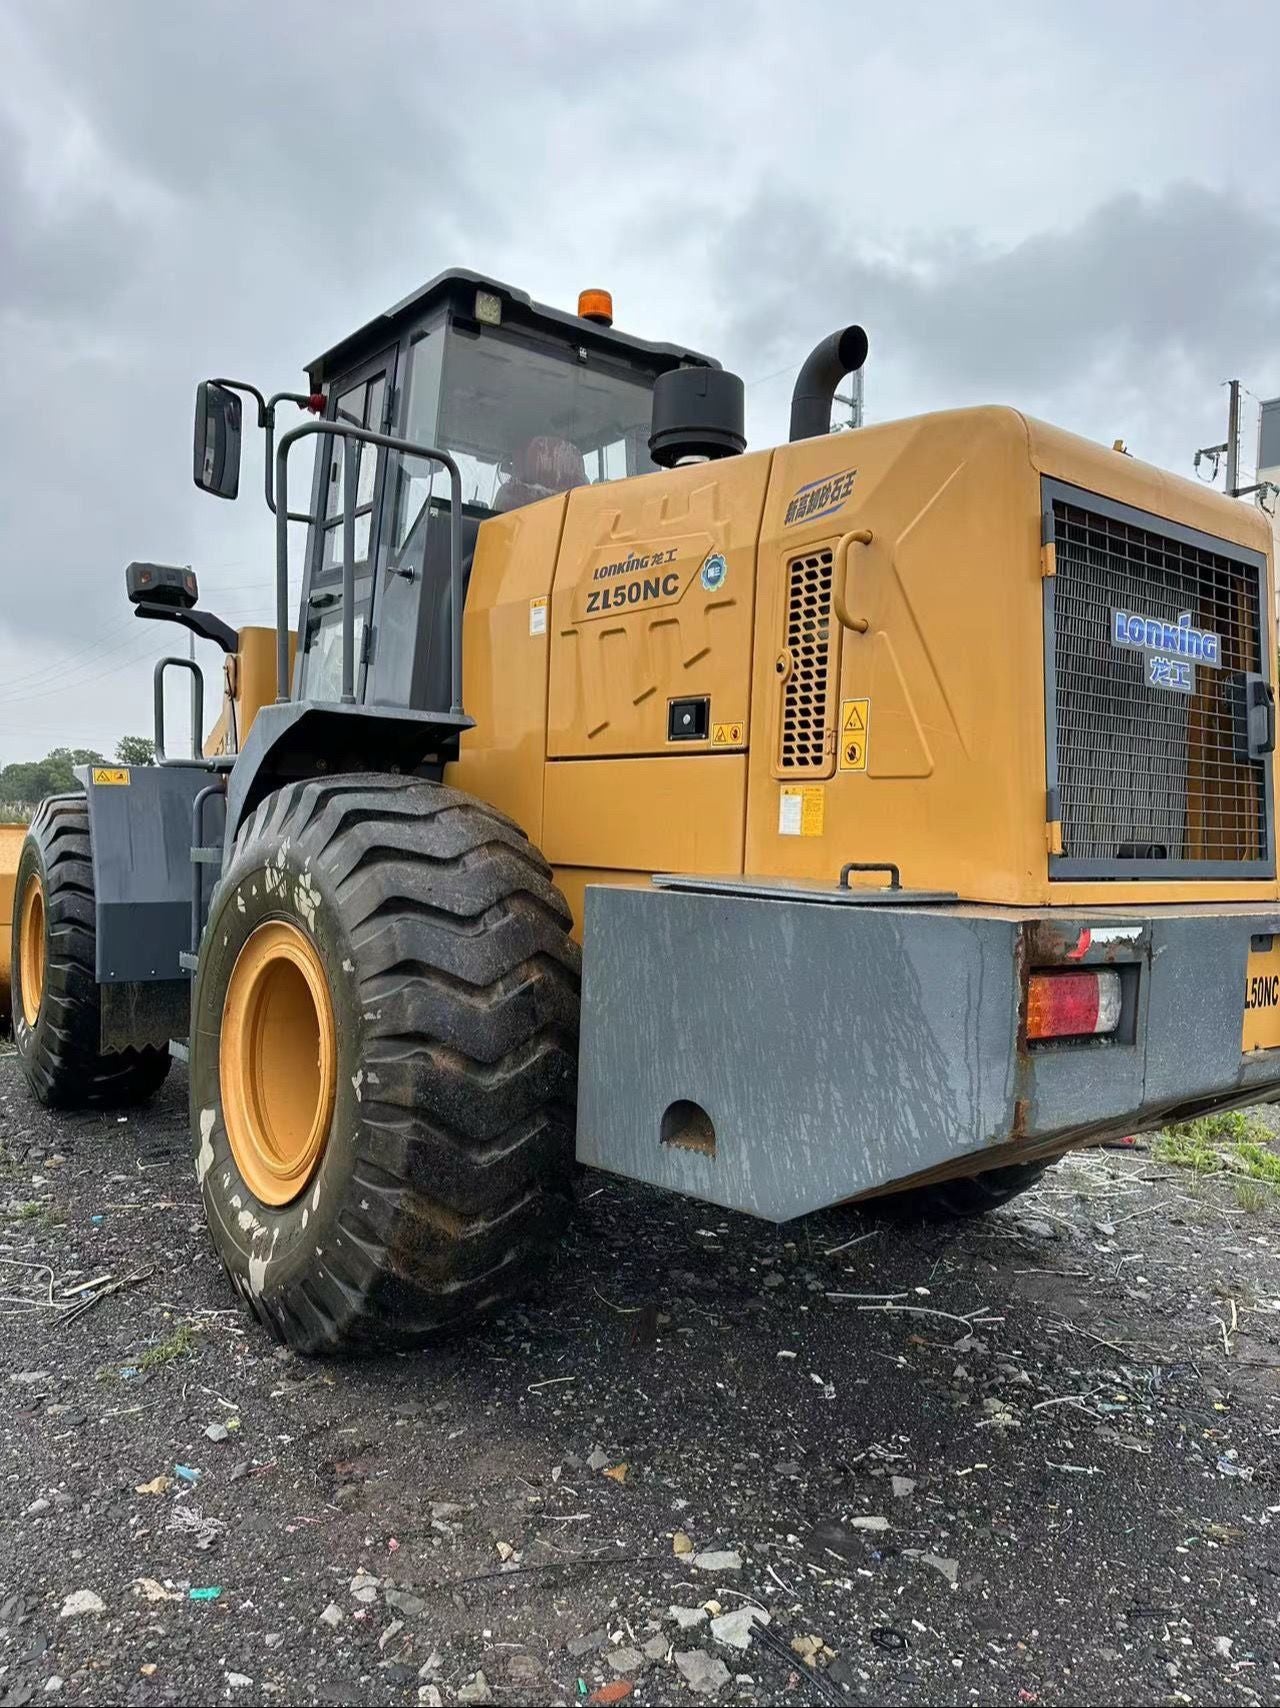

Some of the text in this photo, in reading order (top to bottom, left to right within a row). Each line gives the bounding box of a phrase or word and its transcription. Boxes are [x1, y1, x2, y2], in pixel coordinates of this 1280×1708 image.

[651, 548, 678, 566] 龙工
[586, 573, 680, 613] ZL50NC
[1149, 656, 1191, 690] 龙工
[1244, 975, 1279, 1009] L50NC
